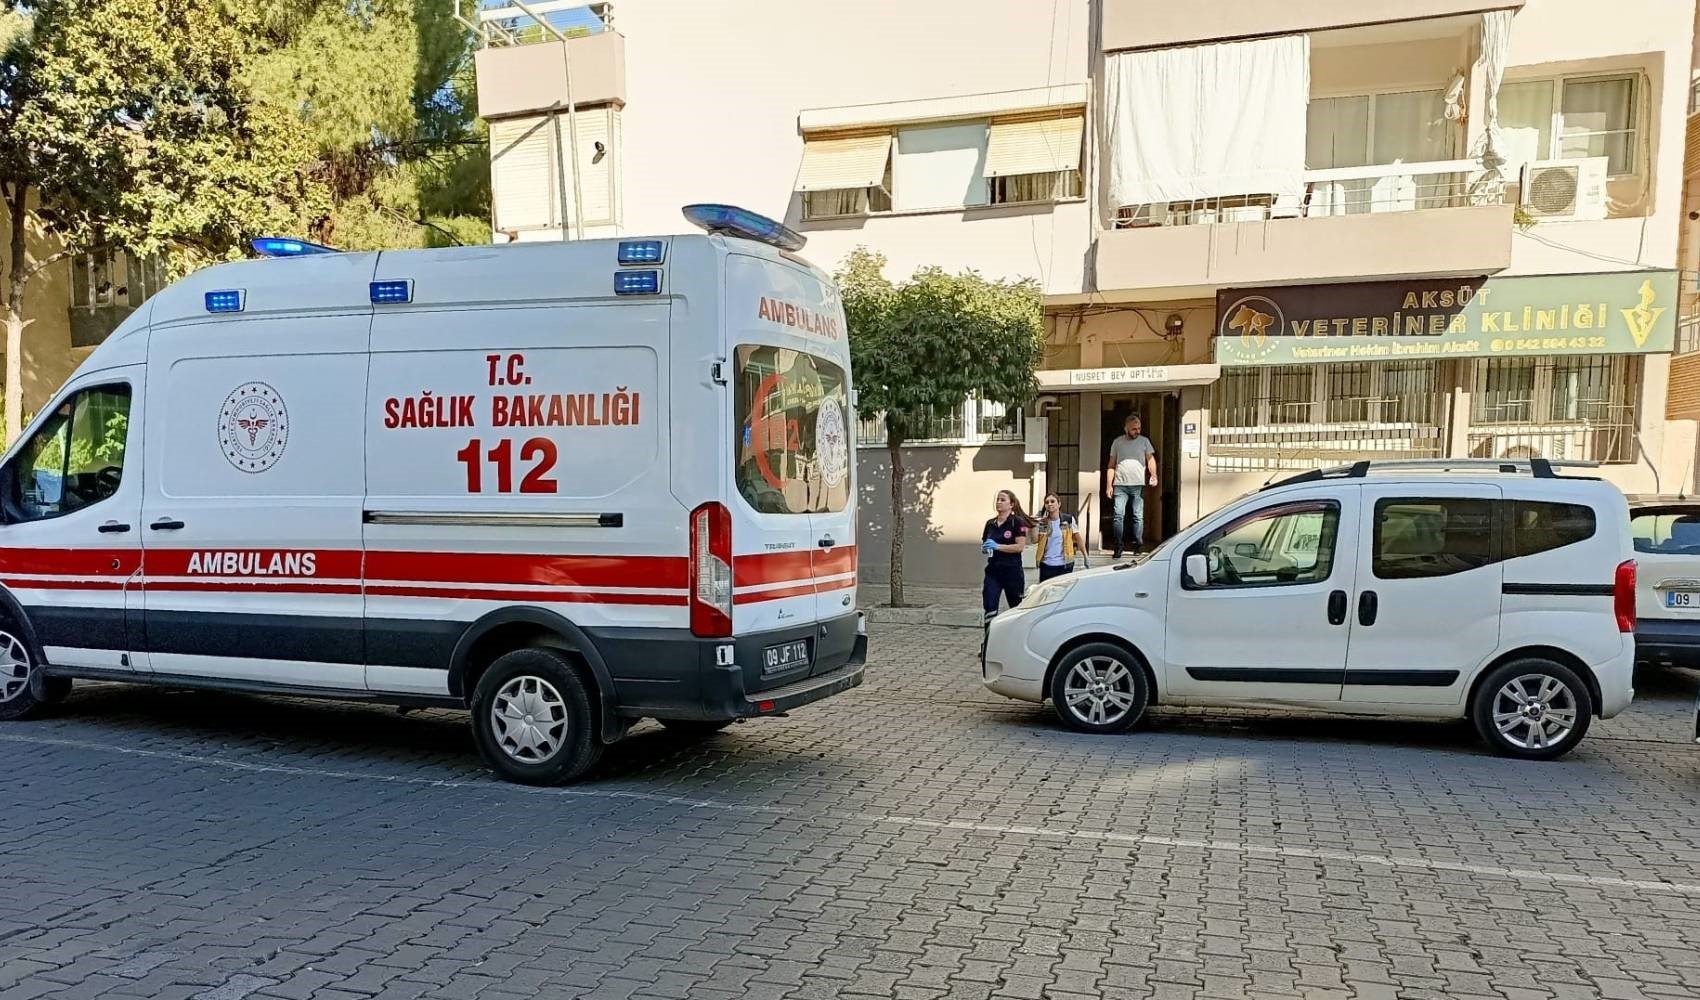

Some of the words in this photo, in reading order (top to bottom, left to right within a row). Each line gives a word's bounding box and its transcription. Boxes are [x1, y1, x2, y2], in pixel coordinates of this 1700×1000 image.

[1402, 285, 1491, 309] AKSÜT
[759, 297, 838, 340] AMBULANS
[1290, 312, 1467, 340] VETERİNER
[1481, 303, 1607, 333] KLİNİĞİ
[1292, 345, 1348, 358] Veteriner
[1350, 343, 1390, 357] Hekim
[486, 354, 532, 386] T.C.
[1075, 371, 1106, 381] NUSRET
[1111, 370, 1126, 380] BEY
[384, 390, 476, 428] SAĞLIK
[492, 386, 640, 427] BAKANLIĞI
[457, 437, 558, 493] 112
[187, 552, 317, 577] AMBULANS
[1675, 593, 1690, 605] 09
[767, 648, 779, 666] 09
[779, 645, 791, 664] JF
[792, 642, 807, 661] 112
